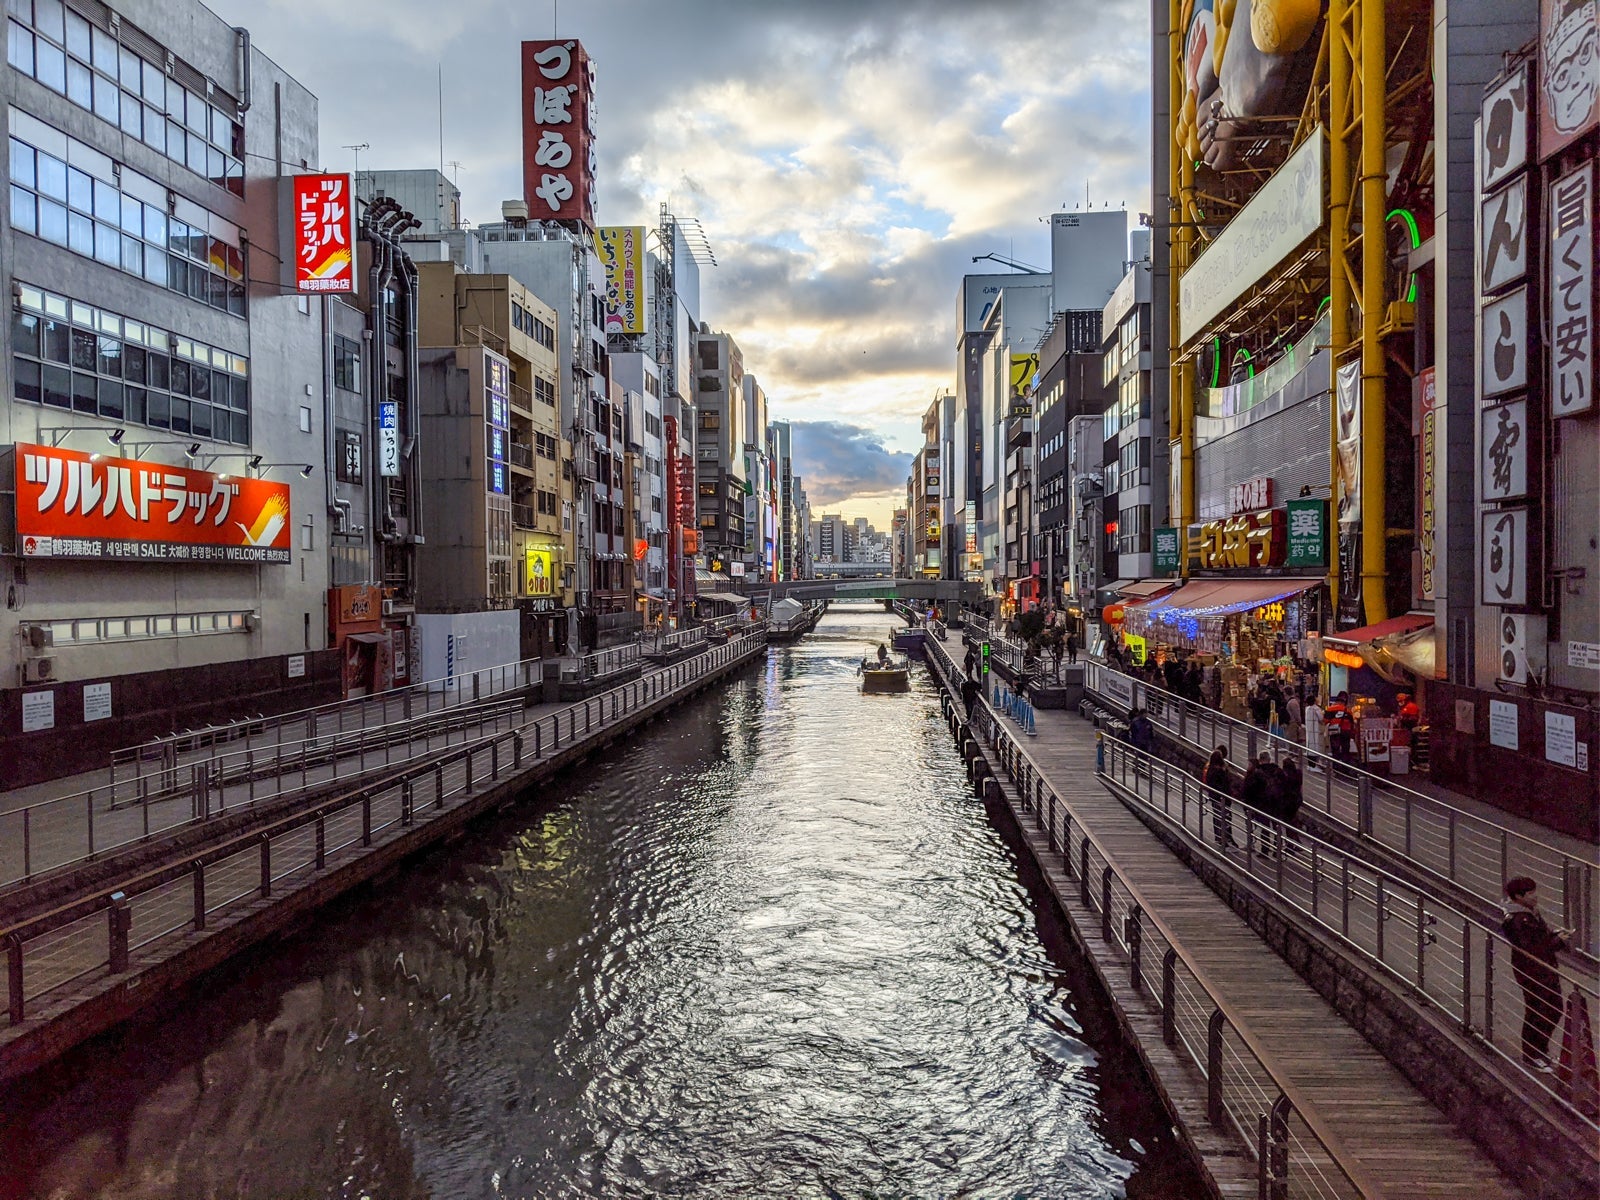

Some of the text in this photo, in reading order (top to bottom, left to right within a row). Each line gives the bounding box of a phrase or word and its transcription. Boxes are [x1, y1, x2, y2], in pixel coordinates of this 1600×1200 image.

[533, 40, 578, 212] づぼらや
[300, 192, 321, 264] ドラッグ
[321, 179, 345, 246] ツルハ
[599, 229, 621, 316] いちごなび
[1556, 174, 1588, 407] 旨くて安い
[383, 404, 396, 474] 焼肉 いろりや
[24, 453, 239, 526] ツルハドラッグ
[1291, 509, 1320, 537] 薬
[106, 542, 139, 557] 세일판매
[141, 543, 167, 558] SALE
[191, 546, 225, 560] 환영합니다
[226, 548, 267, 561] WELCOME
